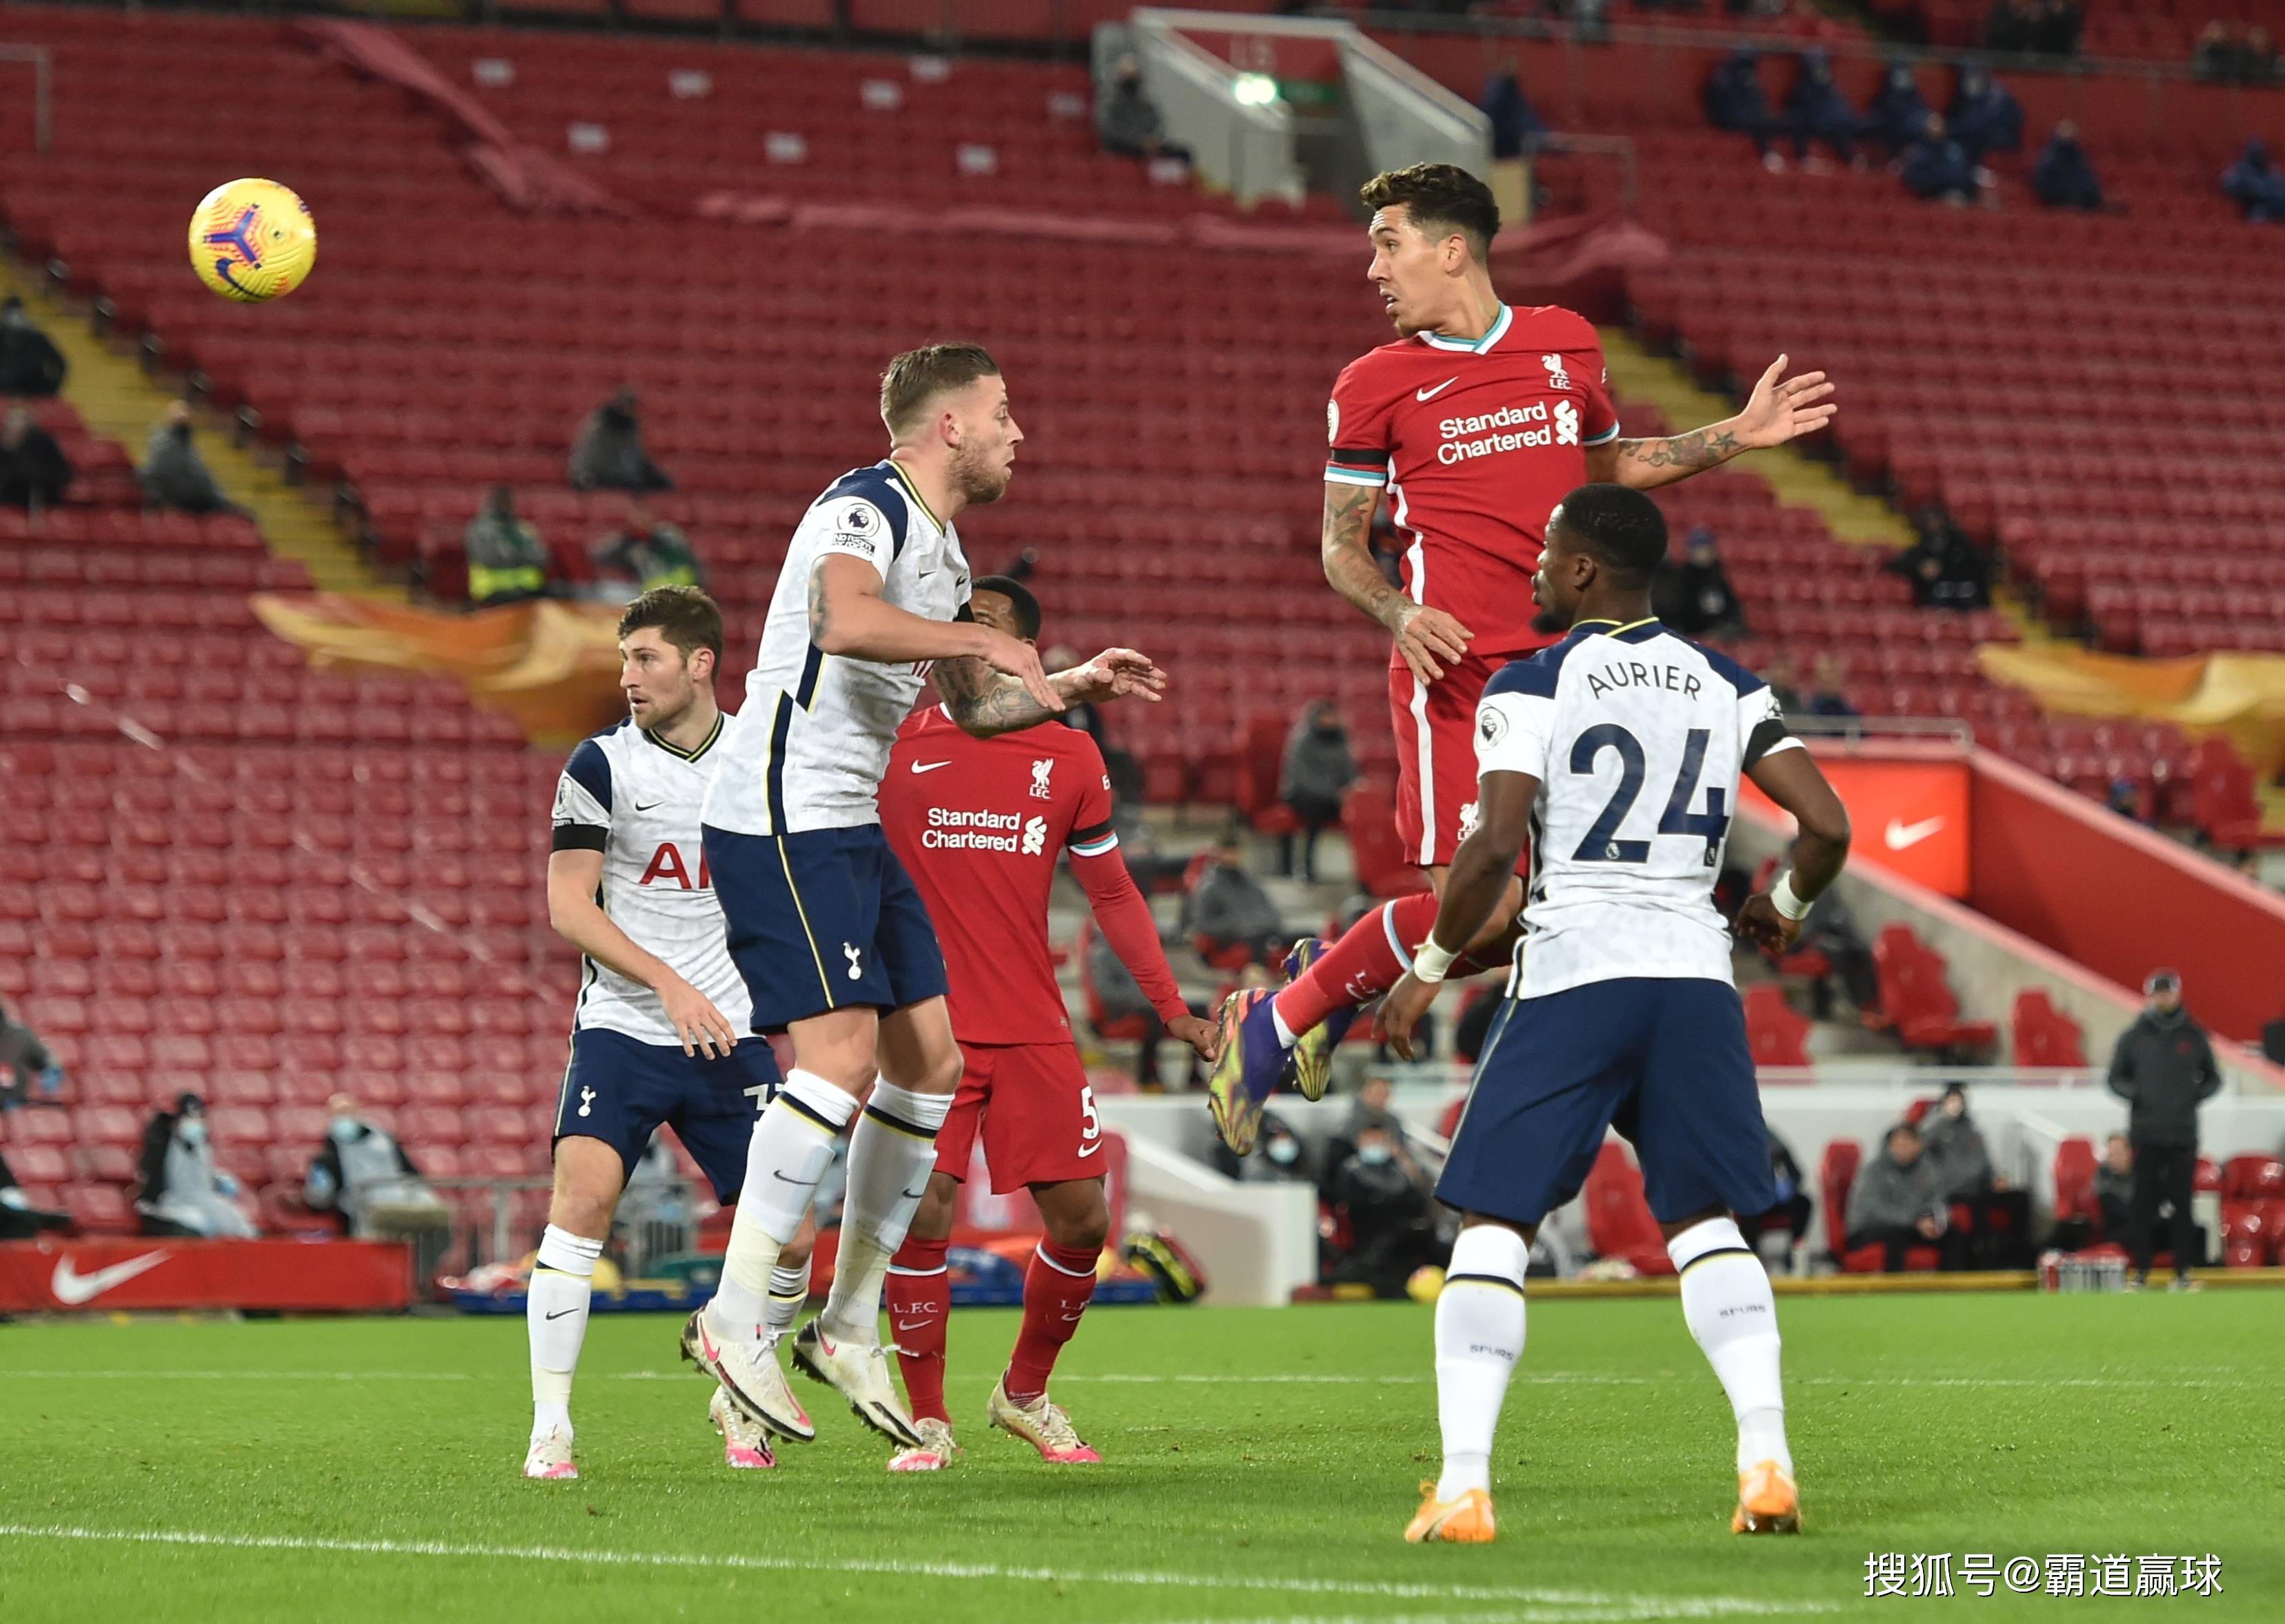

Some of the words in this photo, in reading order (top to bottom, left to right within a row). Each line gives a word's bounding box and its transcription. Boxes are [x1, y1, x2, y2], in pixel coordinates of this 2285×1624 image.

[1439, 401, 1548, 439] Standard
[1437, 424, 1551, 465] Chartered
[1586, 662, 1702, 702] AURIER
[1569, 722, 1730, 868] 24
[928, 807, 1021, 830] Standard
[921, 829, 1018, 852] Chartered
[1081, 1085, 1100, 1139] 5
[1470, 1345, 1515, 1362] SPURS
